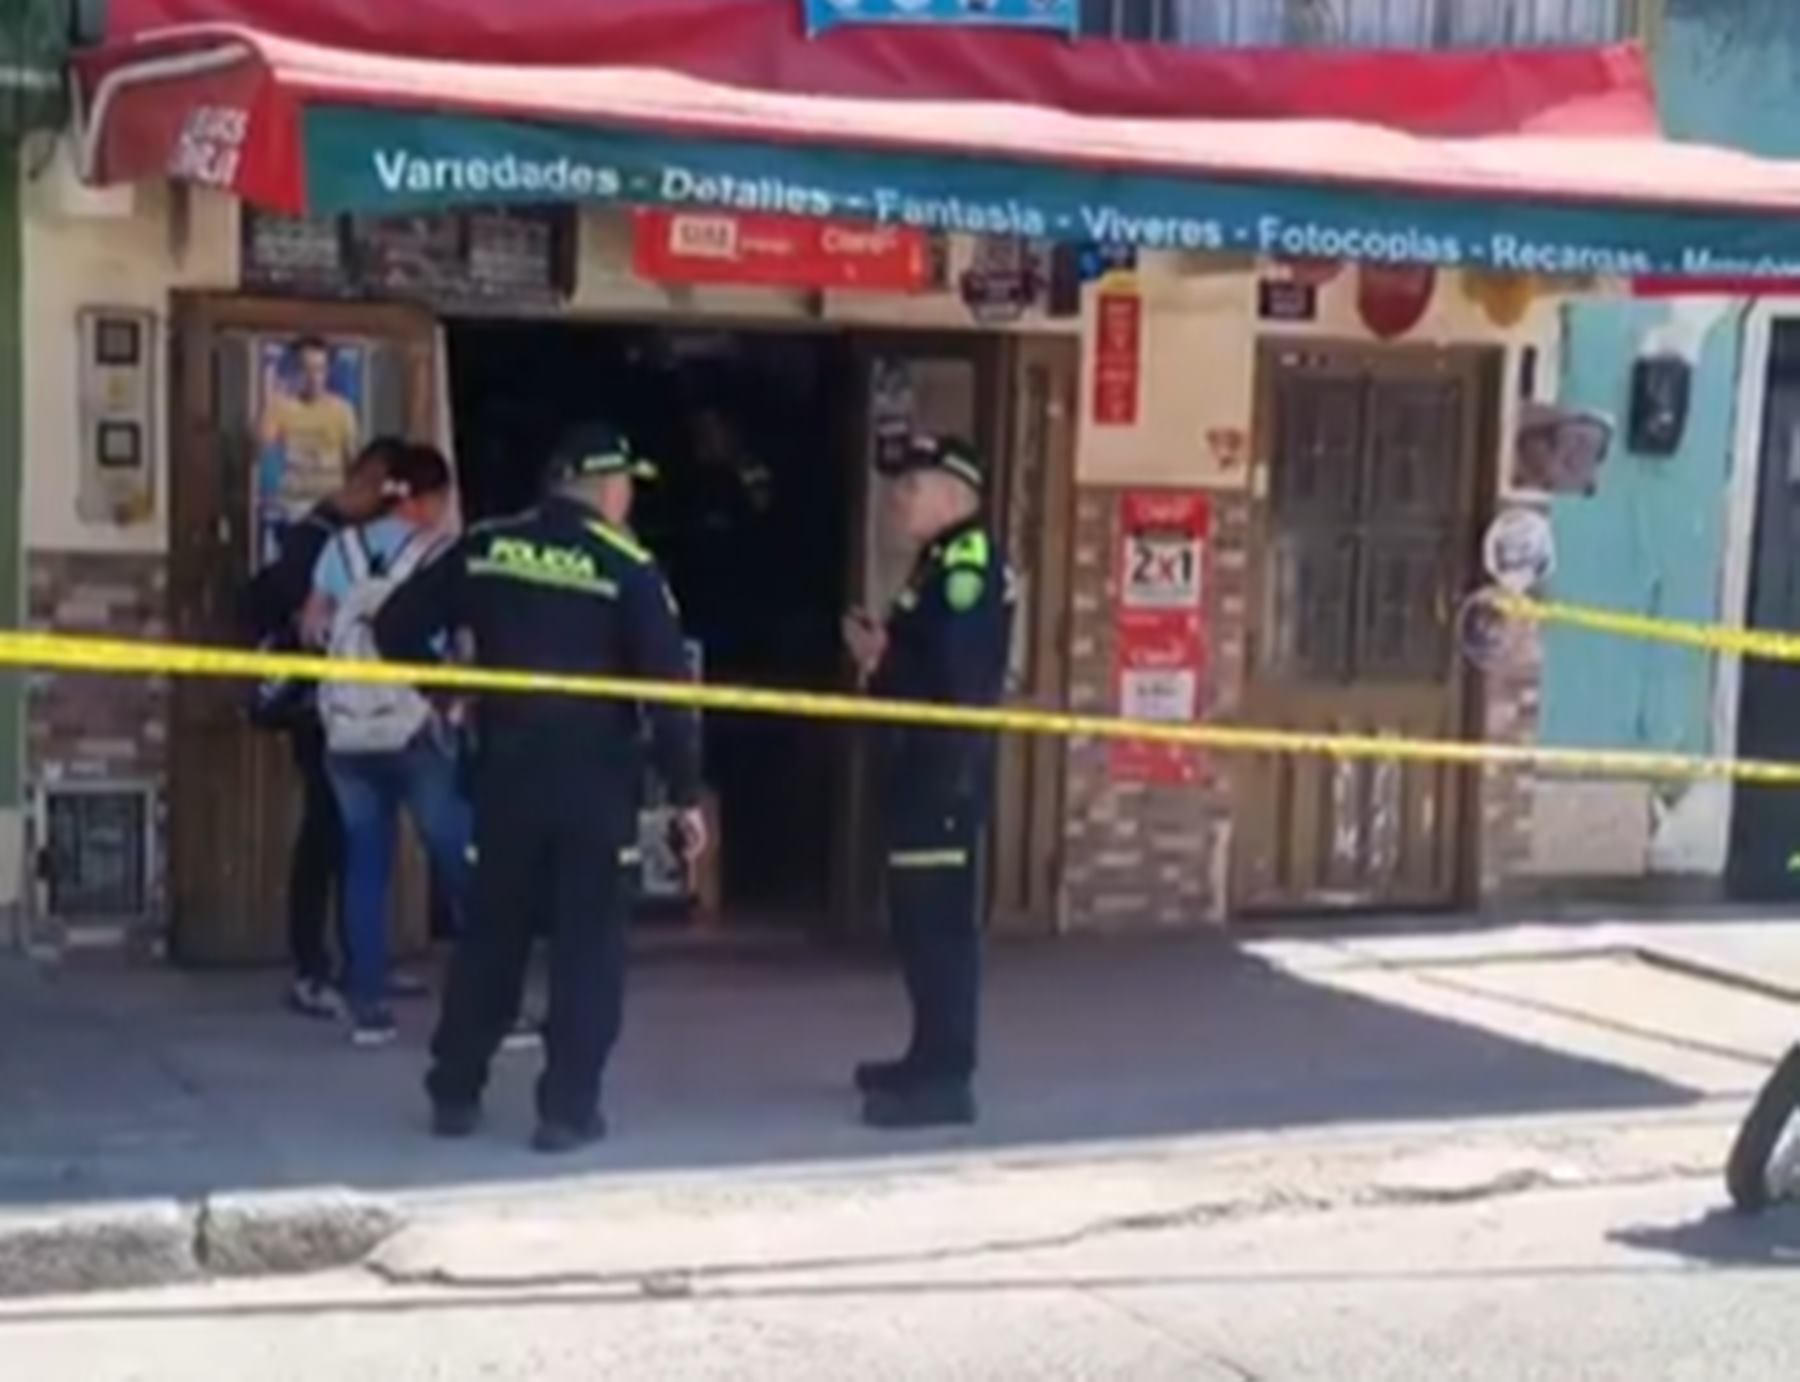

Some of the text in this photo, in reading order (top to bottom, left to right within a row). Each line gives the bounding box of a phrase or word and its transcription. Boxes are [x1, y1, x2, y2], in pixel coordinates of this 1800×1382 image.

[374, 150, 619, 195] Variedades
[1258, 214, 1461, 262] Fotocopias
[1131, 545, 1194, 585] 2x1
